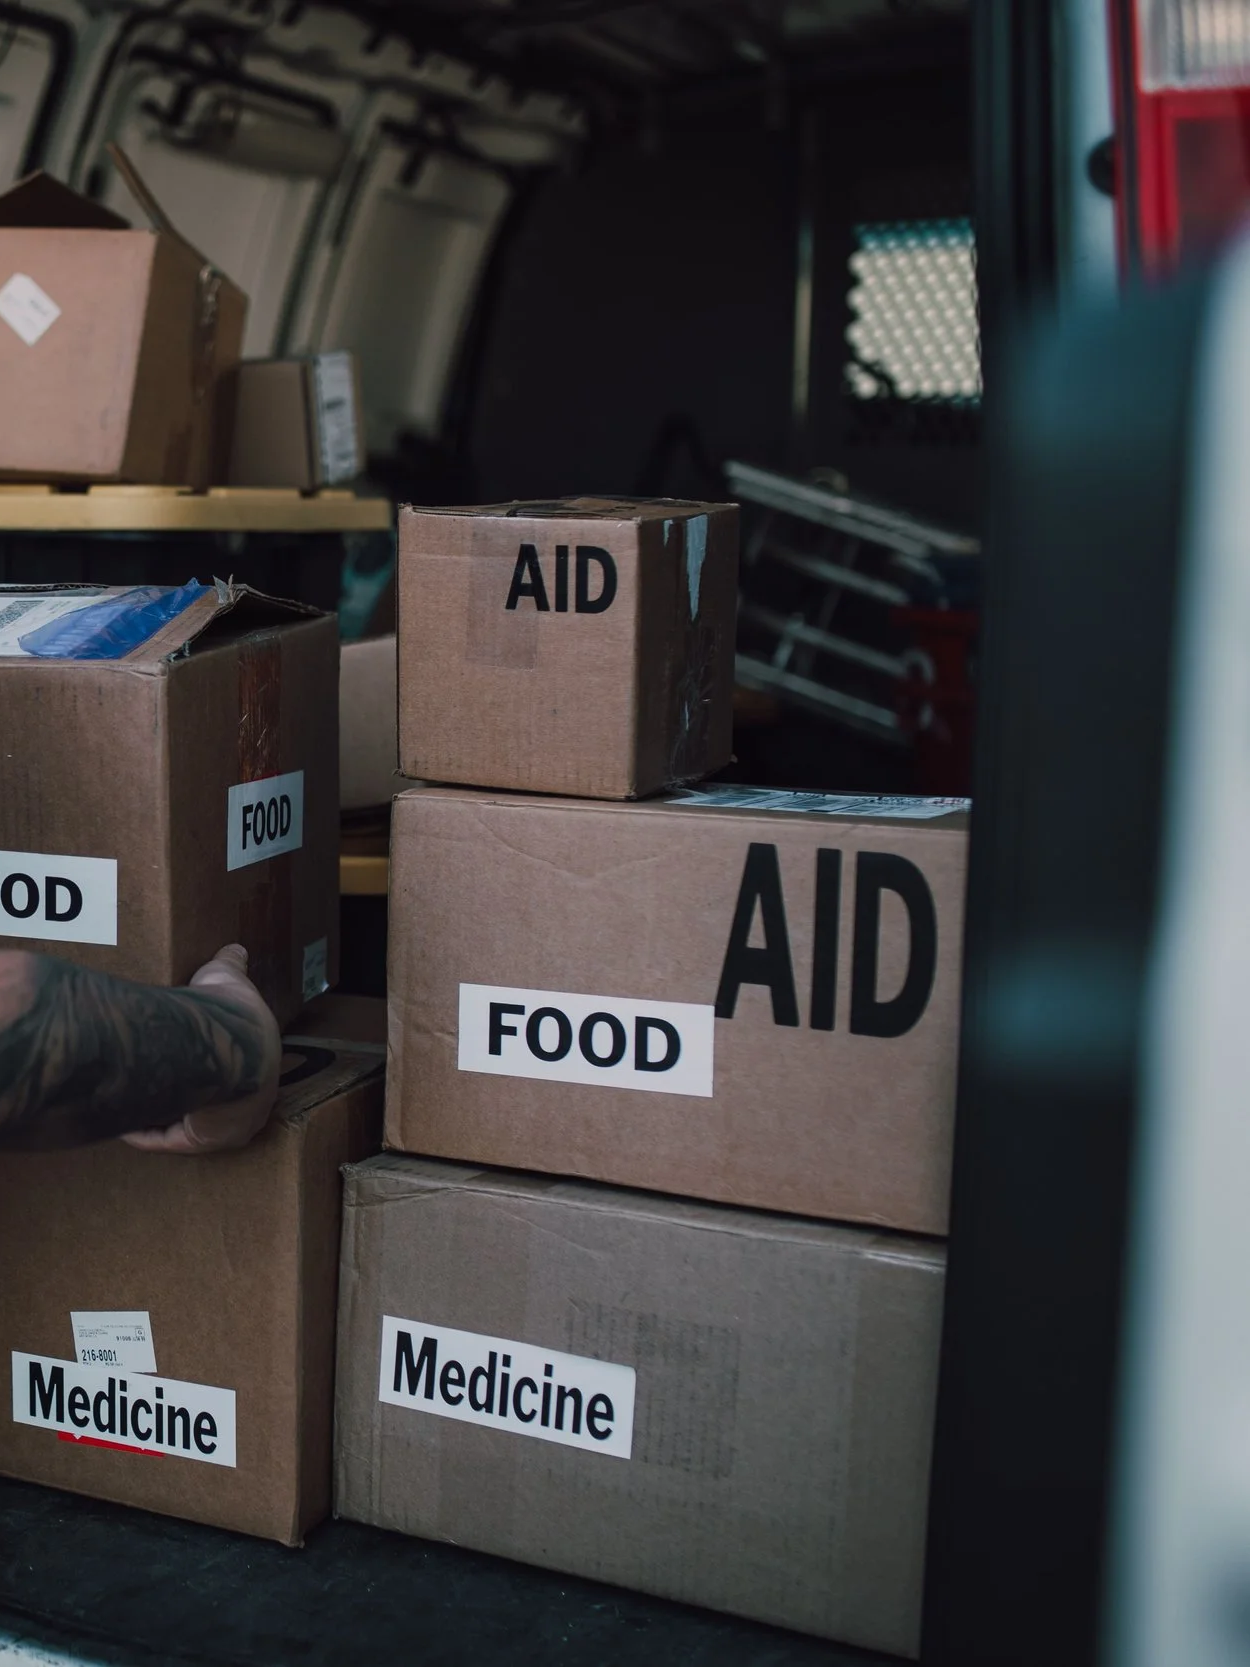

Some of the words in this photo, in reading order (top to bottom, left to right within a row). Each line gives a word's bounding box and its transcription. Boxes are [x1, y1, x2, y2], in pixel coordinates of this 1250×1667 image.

[505, 543, 618, 614] AID
[242, 794, 292, 850] FOOD
[715, 842, 938, 1038] AID
[488, 1001, 682, 1073] FOOD
[81, 1349, 117, 1362] 216-8001
[393, 1330, 614, 1440] Medicine
[28, 1361, 218, 1455] Medicine
